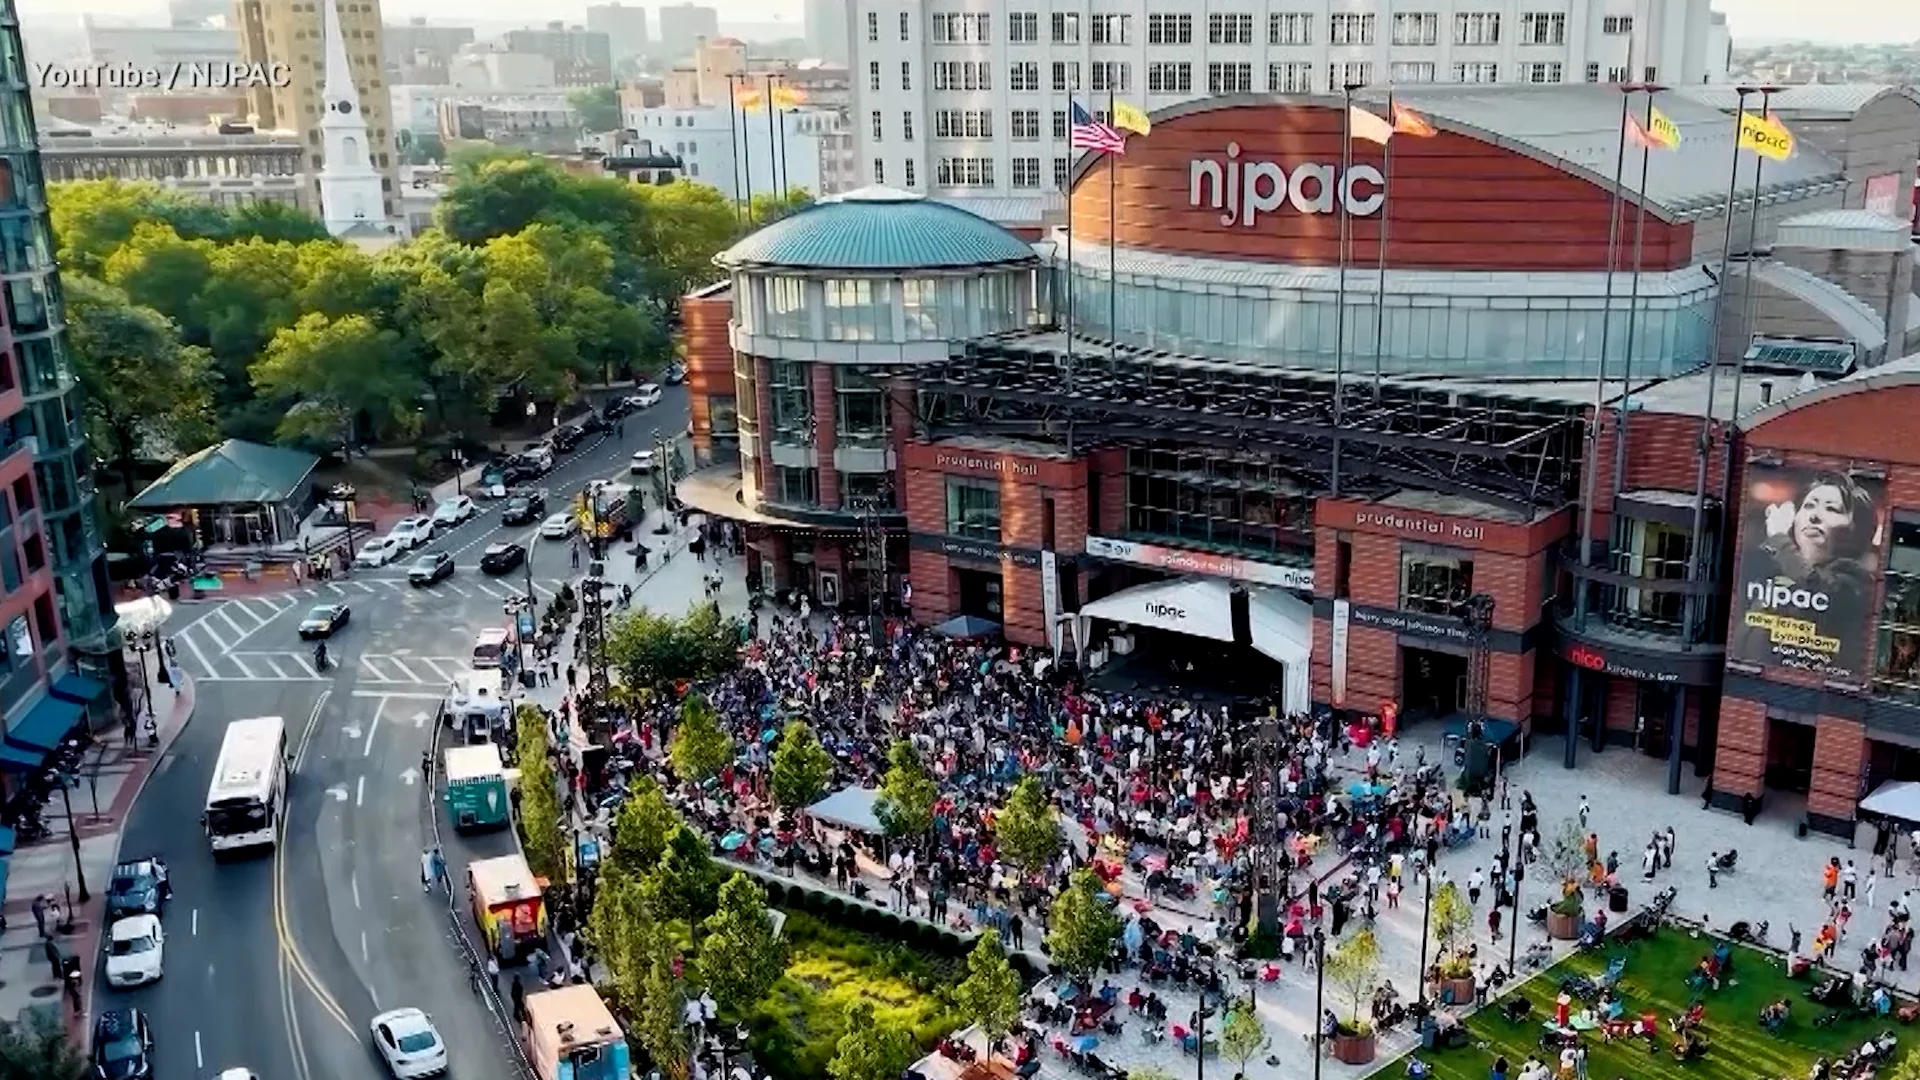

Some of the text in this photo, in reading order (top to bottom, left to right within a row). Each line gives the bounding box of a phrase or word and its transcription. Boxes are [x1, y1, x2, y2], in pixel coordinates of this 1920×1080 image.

[1189, 141, 1385, 227] njpac
[936, 454, 1038, 476] prudential hall
[1356, 511, 1484, 540] prudential hall
[1747, 578, 1830, 612] njpac
[1145, 600, 1186, 618] njpac
[1748, 615, 1773, 626] new
[1774, 633, 1838, 651] symphony
[1571, 647, 1605, 671] nico
